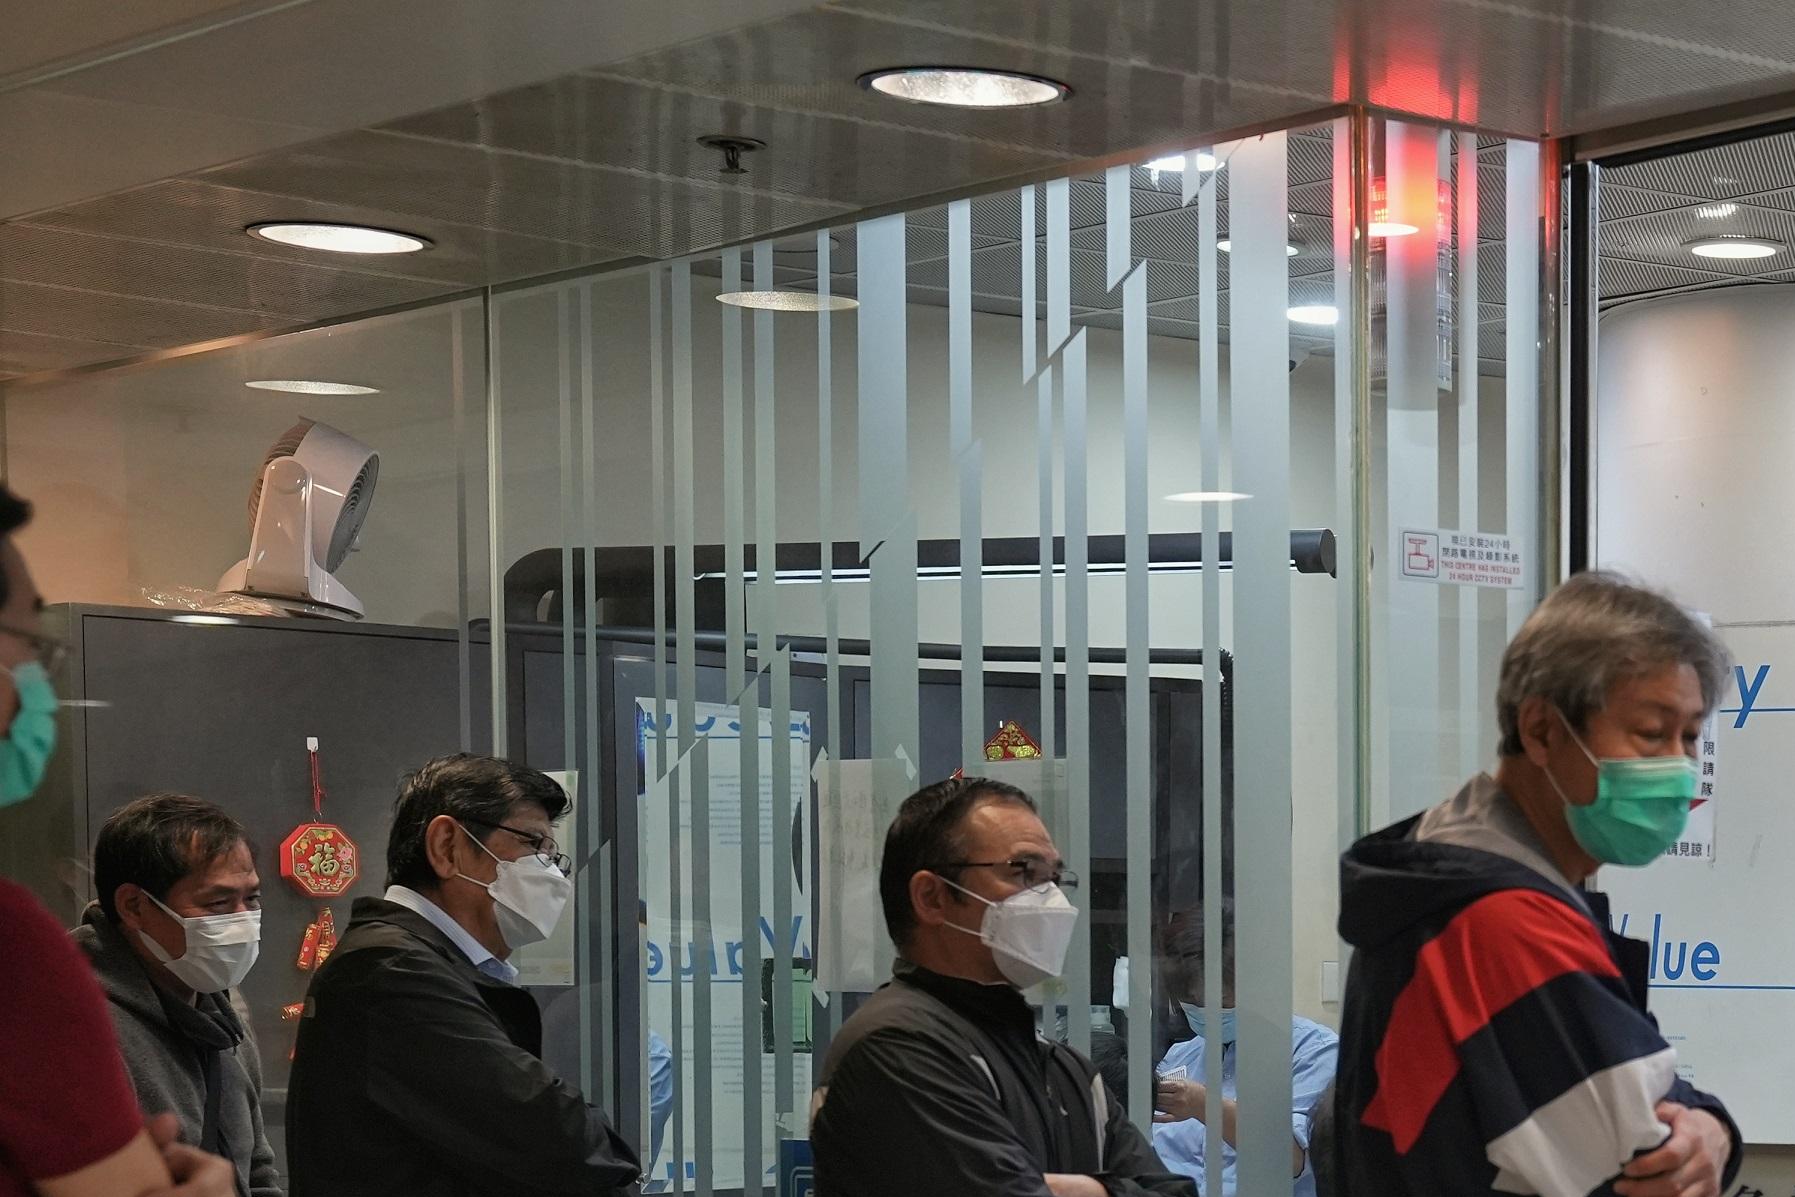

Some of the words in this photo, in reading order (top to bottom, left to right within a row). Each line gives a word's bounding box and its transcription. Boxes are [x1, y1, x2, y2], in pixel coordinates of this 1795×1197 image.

[309, 842, 341, 876] 福
[1664, 843, 1711, 858] 請見諒！
